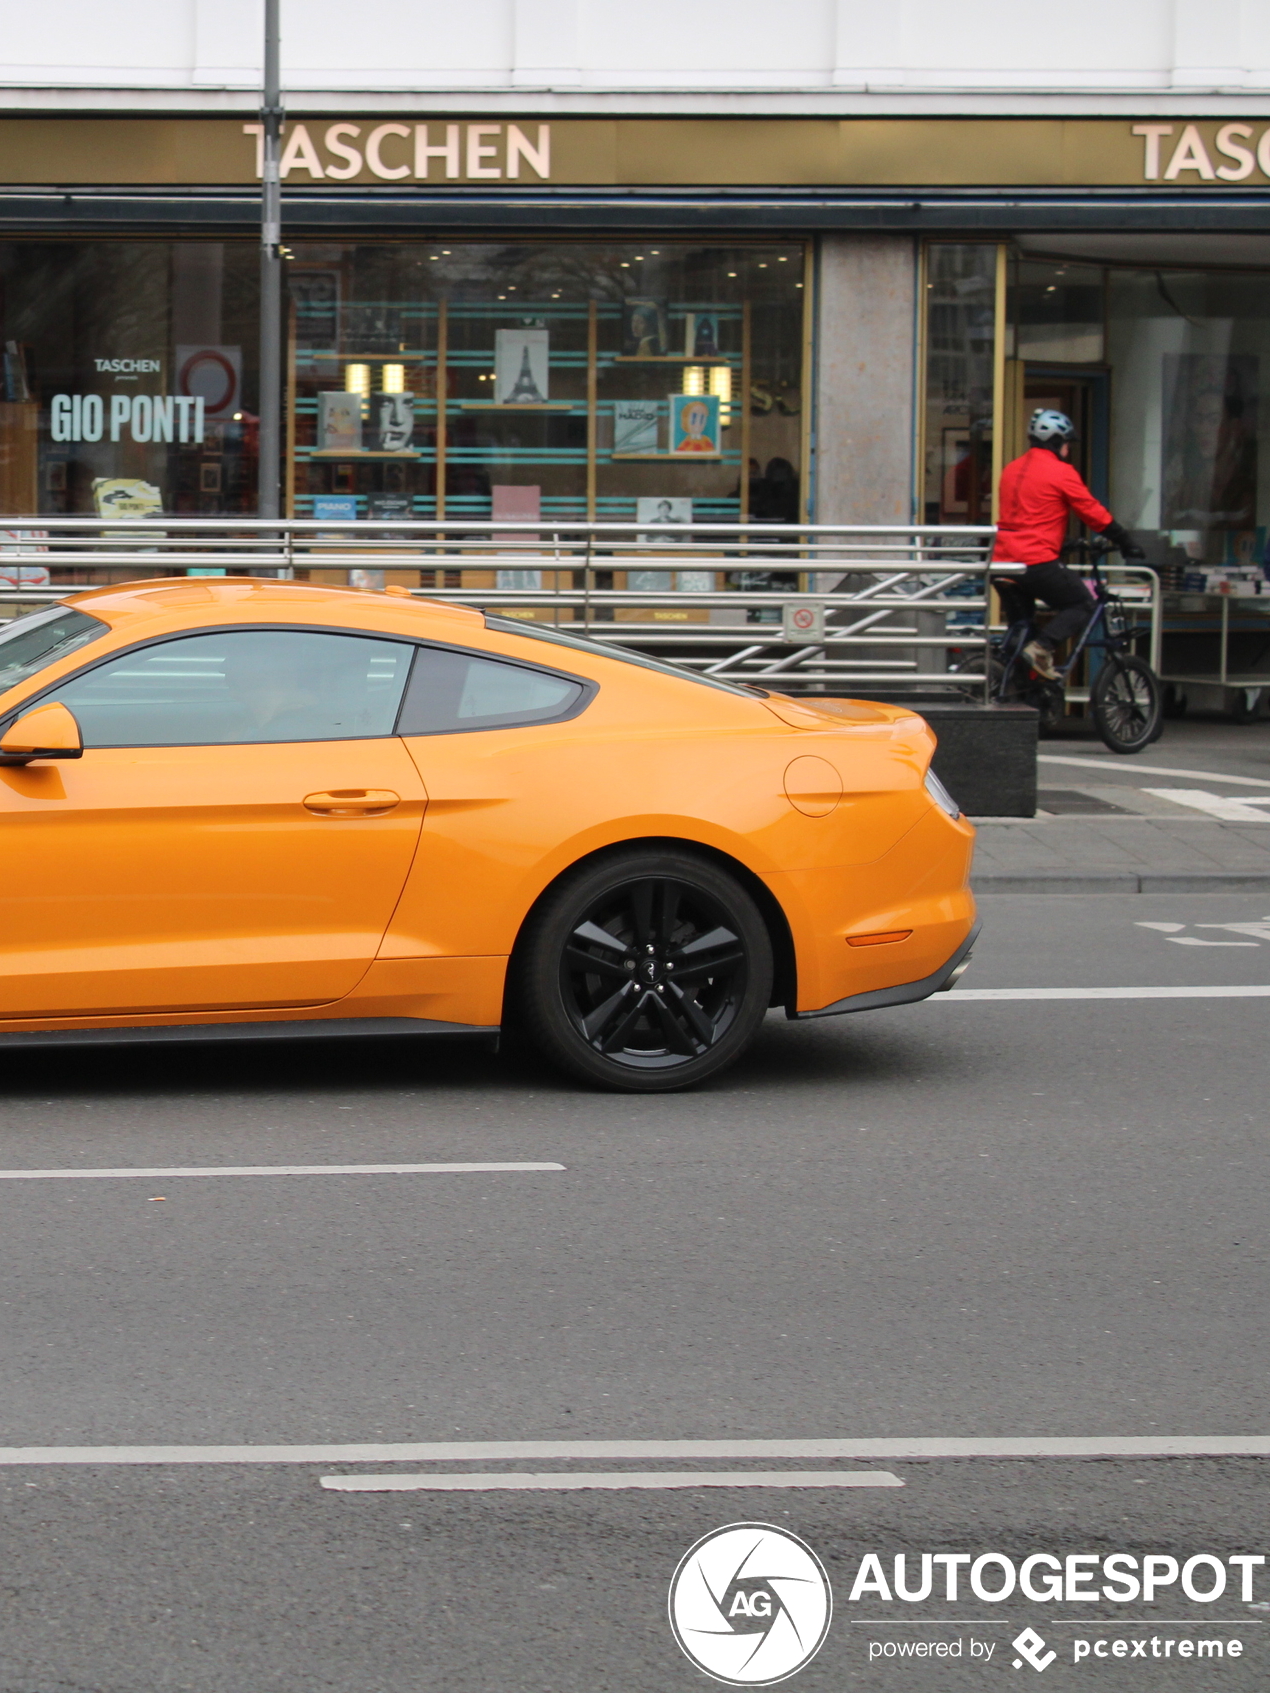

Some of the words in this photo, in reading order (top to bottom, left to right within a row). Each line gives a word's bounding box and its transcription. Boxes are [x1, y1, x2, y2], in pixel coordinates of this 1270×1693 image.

[243, 123, 550, 180] TASCHEN
[94, 358, 160, 373] TASCHEN
[51, 394, 104, 442] GIO
[110, 395, 204, 443] PONTI
[316, 502, 352, 512] PIANO
[653, 611, 688, 620] TASCHEN
